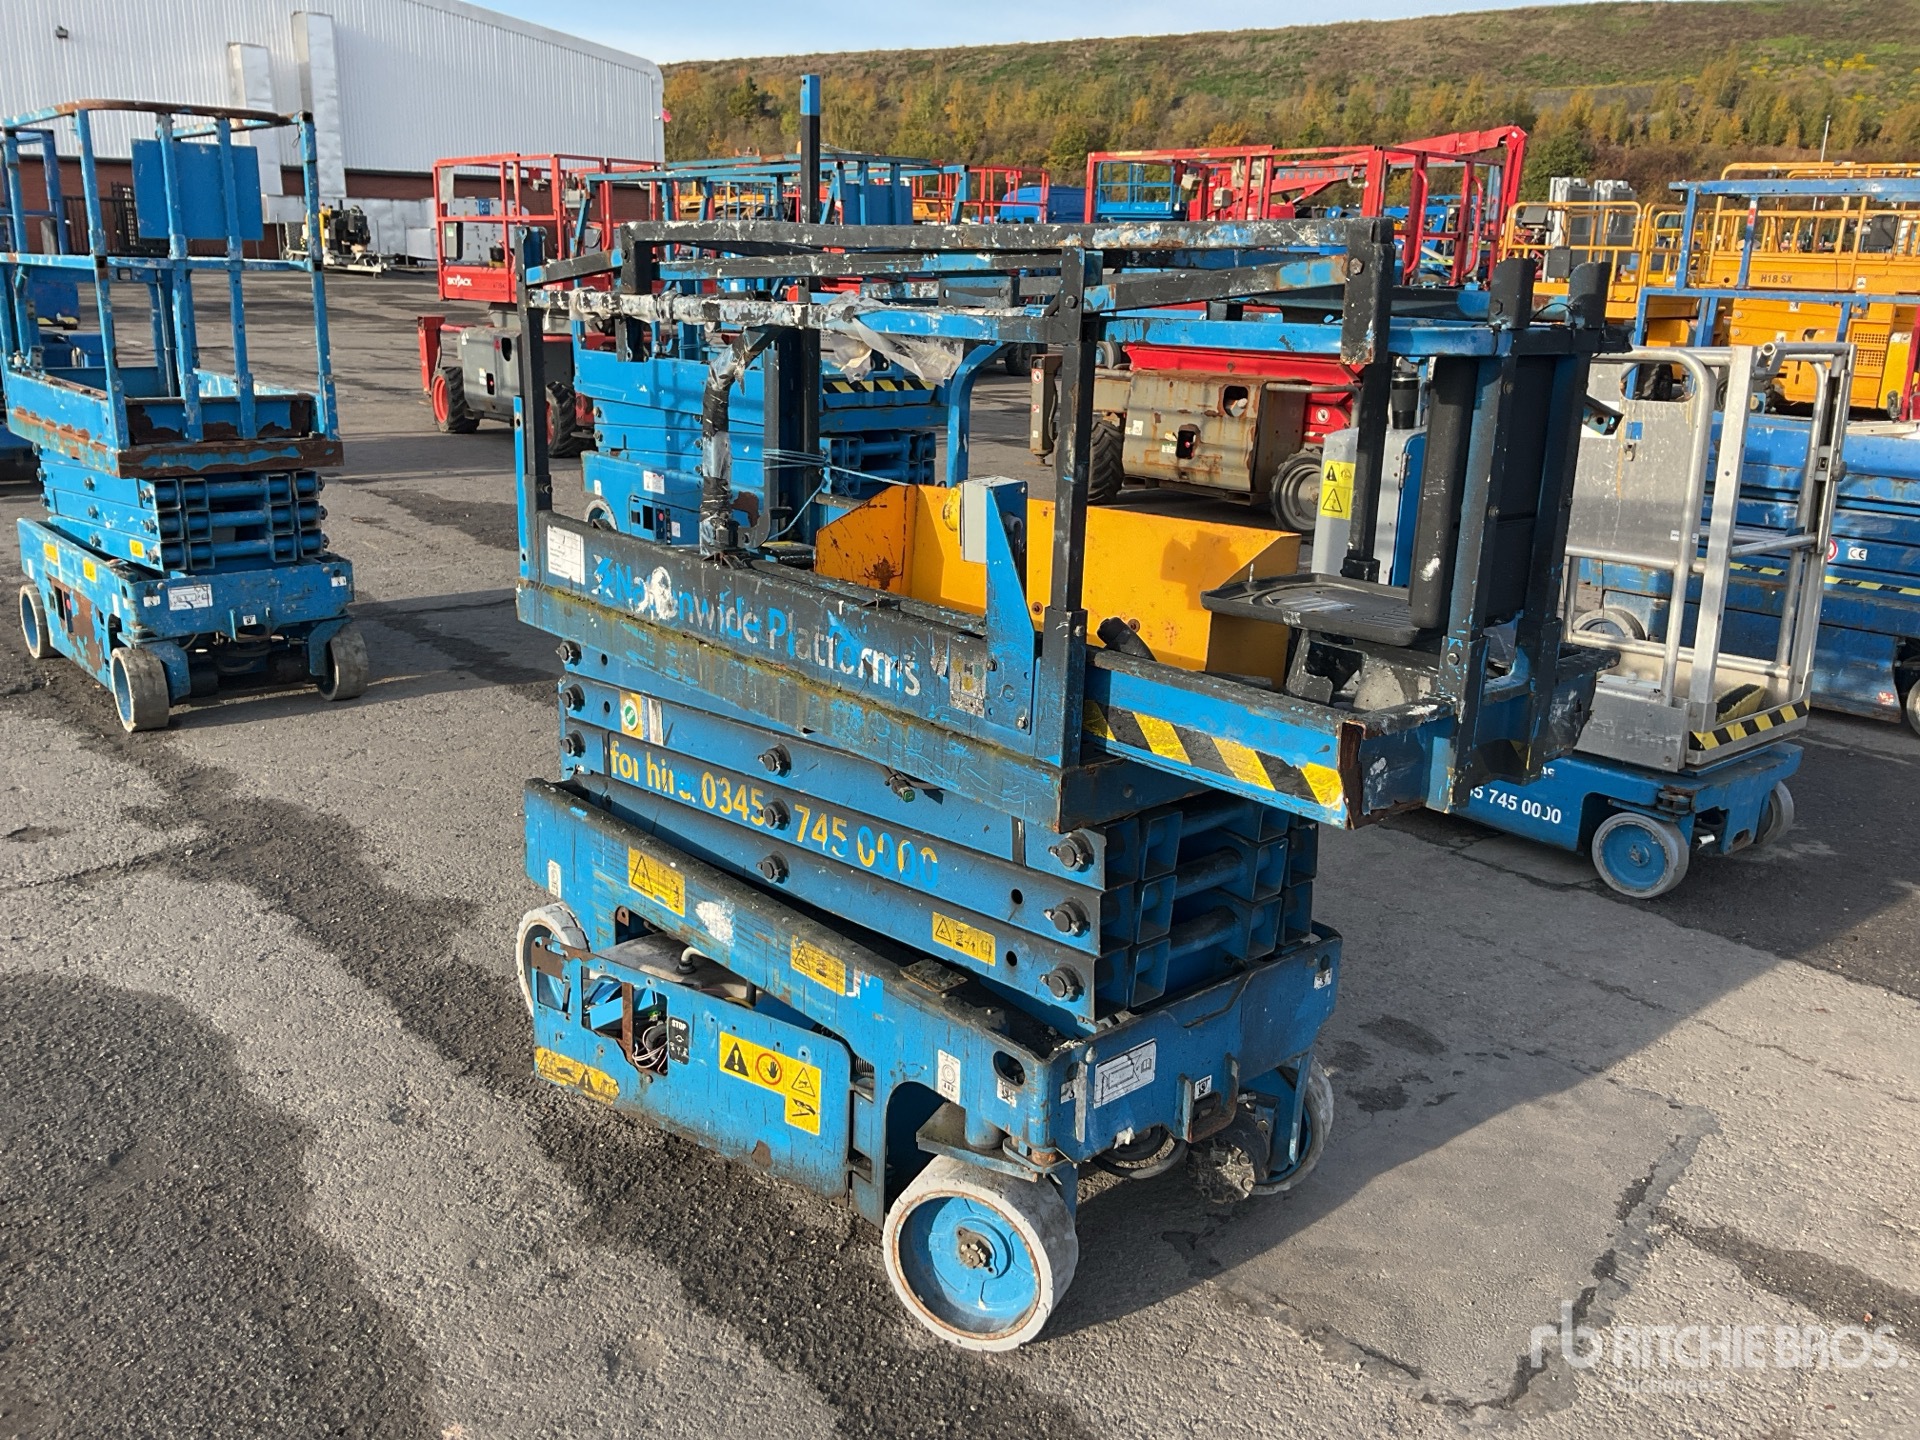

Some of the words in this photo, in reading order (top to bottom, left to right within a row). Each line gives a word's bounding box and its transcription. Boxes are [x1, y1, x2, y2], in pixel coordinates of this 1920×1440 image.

[1760, 273, 1779, 284] H18
[1780, 274, 1793, 284] SX
[1849, 548, 1866, 560] CE
[1489, 789, 1518, 811] 745
[1521, 799, 1562, 824] 0000
[701, 771, 765, 826] 0345
[794, 804, 848, 857] 745
[857, 825, 939, 889] 0000
[671, 1019, 687, 1031] STOP
